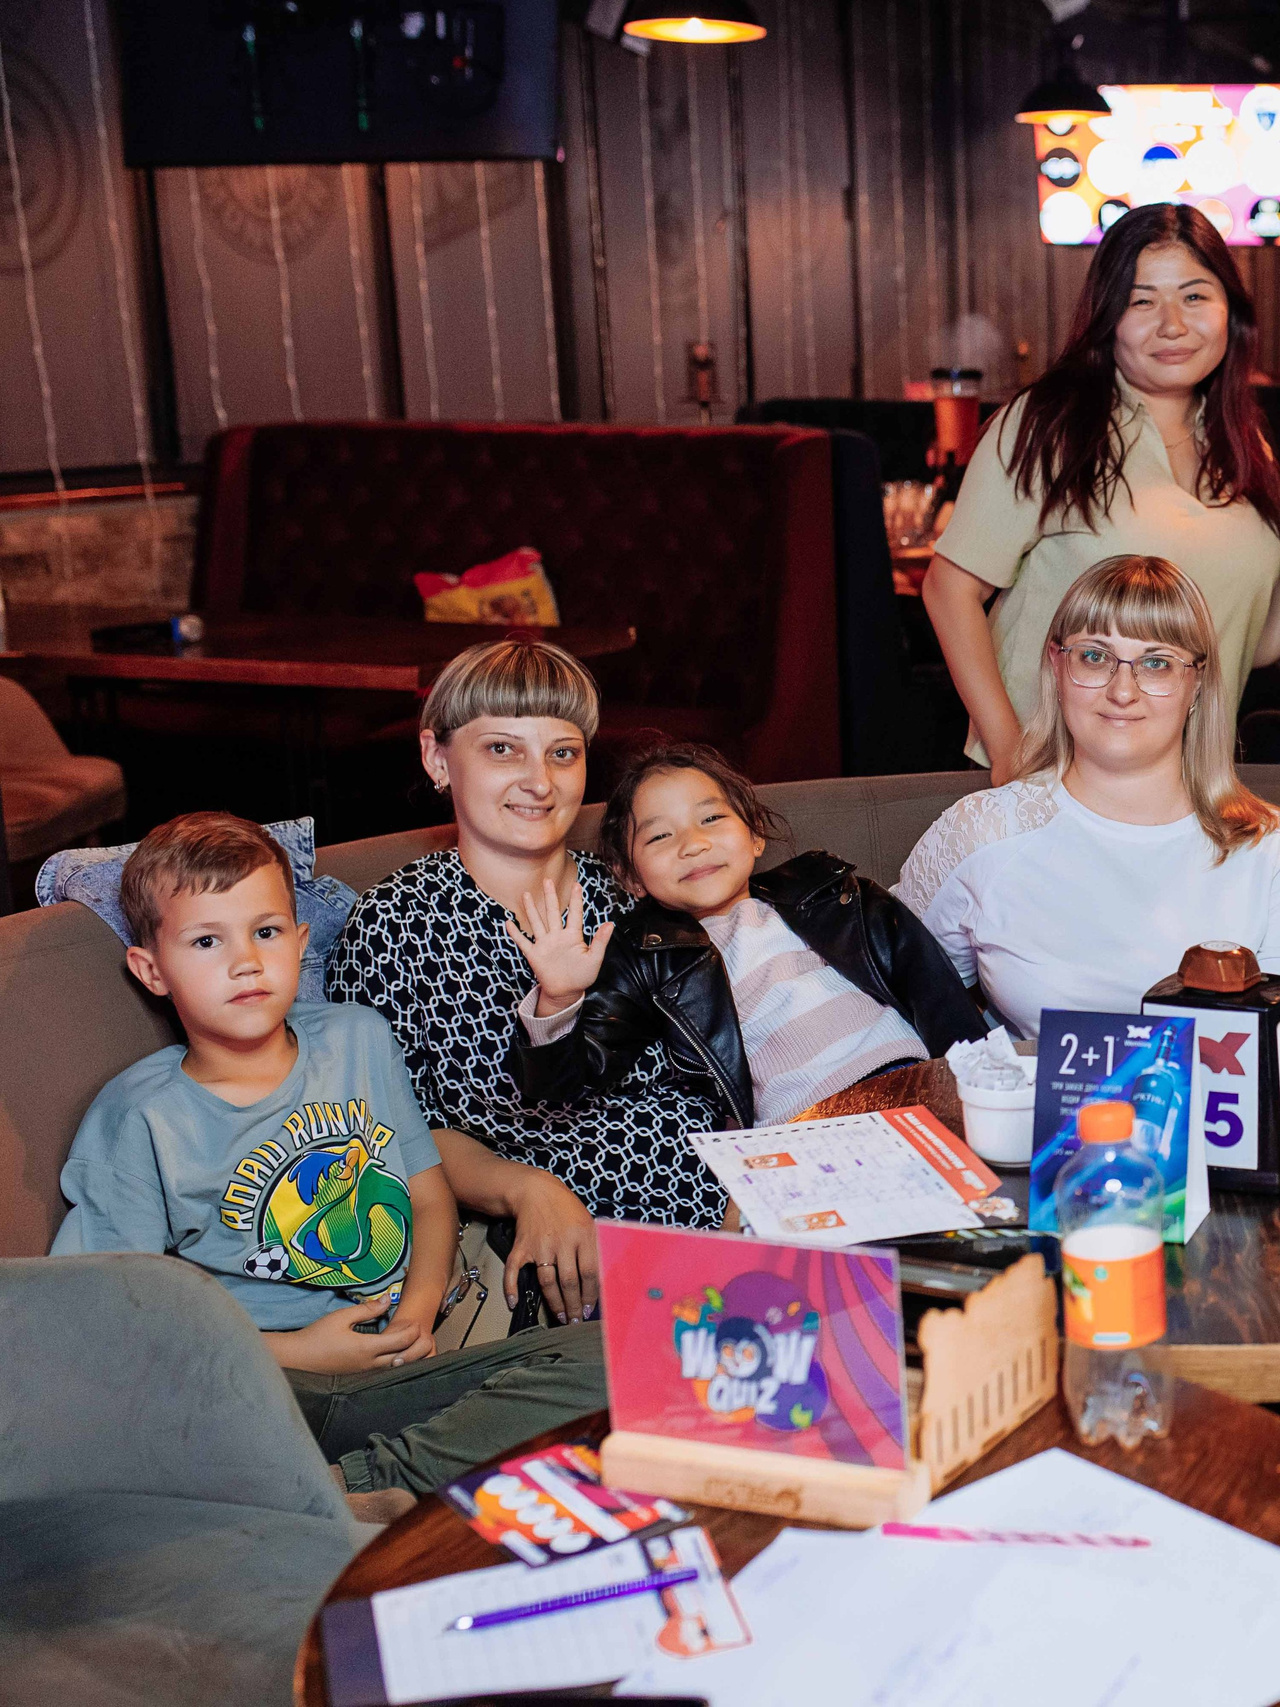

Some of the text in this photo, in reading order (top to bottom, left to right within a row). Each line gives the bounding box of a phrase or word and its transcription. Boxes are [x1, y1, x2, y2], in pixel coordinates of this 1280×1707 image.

[1203, 1090, 1244, 1149] 5
[219, 1139, 290, 1232] ROAD
[707, 1374, 779, 1417] QUIZ
